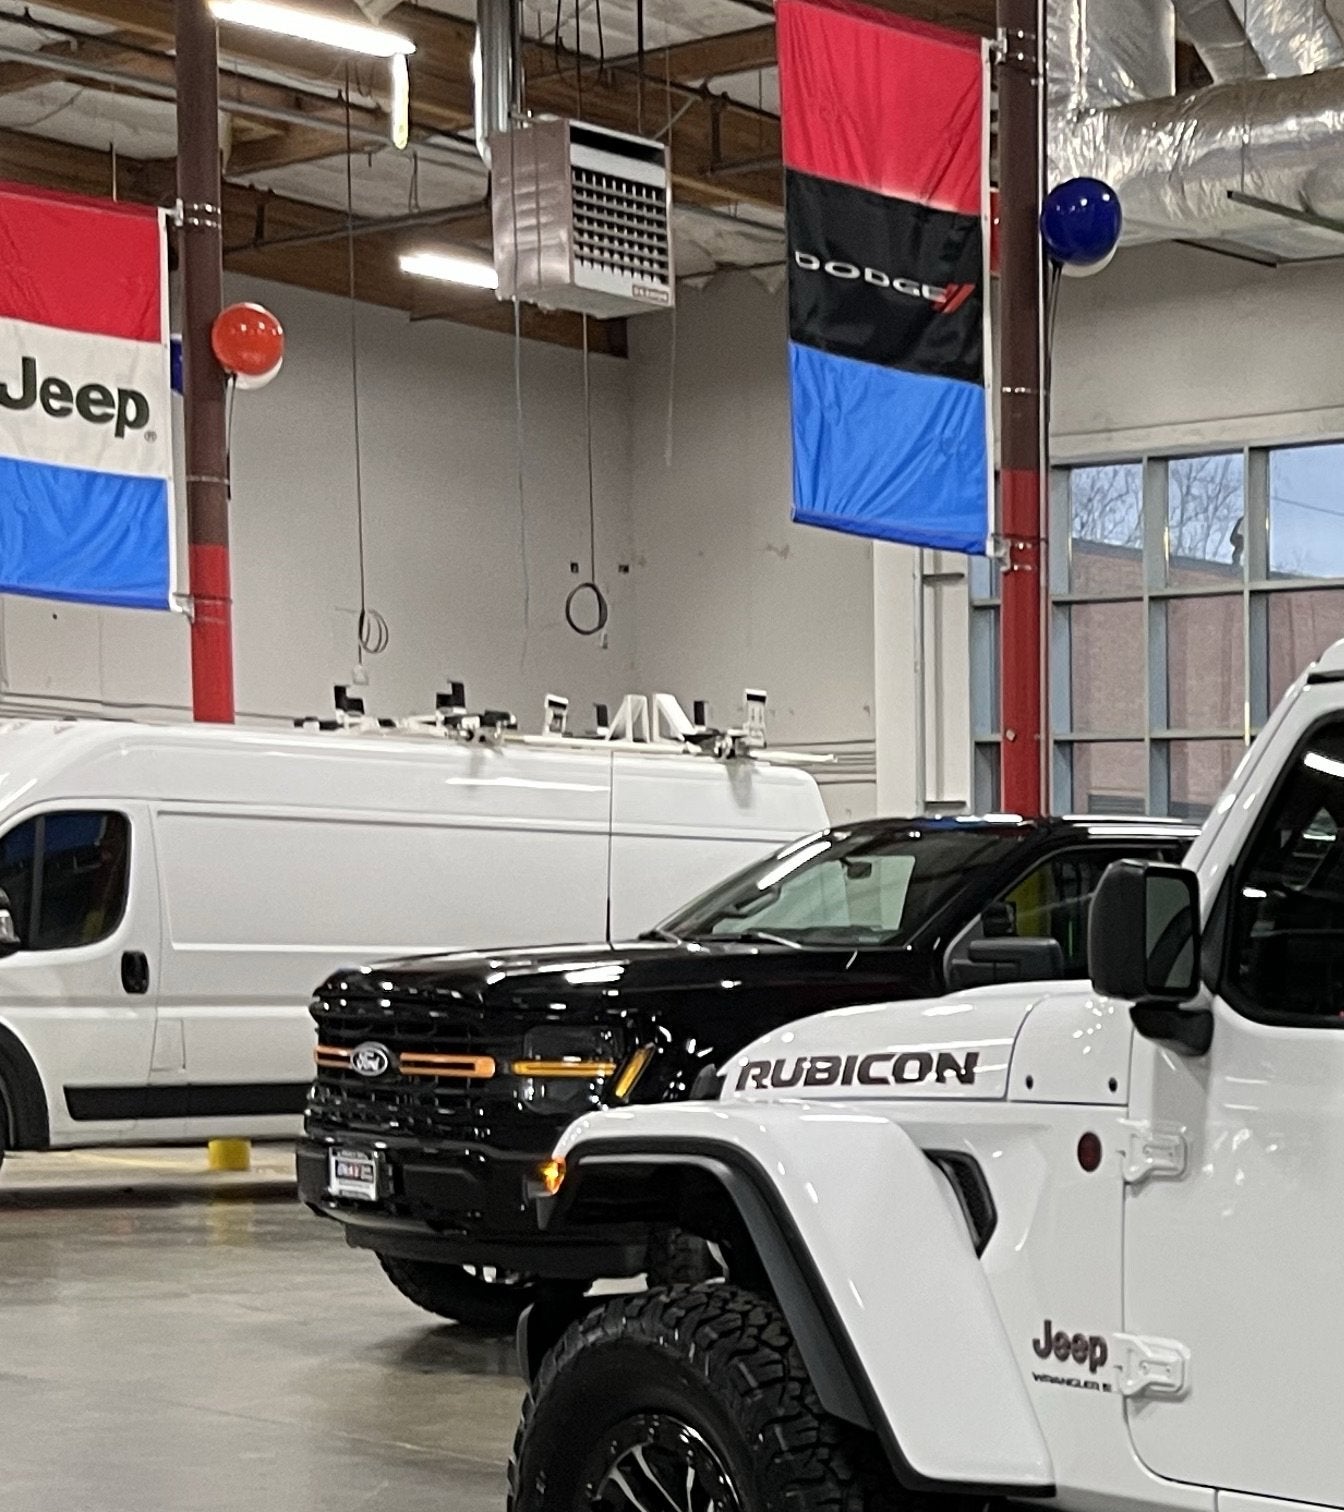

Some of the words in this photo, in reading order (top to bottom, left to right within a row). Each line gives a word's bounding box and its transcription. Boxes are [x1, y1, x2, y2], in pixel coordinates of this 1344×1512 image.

[795, 250, 947, 304] DODGE
[0, 355, 150, 439] Jeep
[735, 1051, 980, 1092] RUBICON
[1031, 1318, 1109, 1375] Jeep
